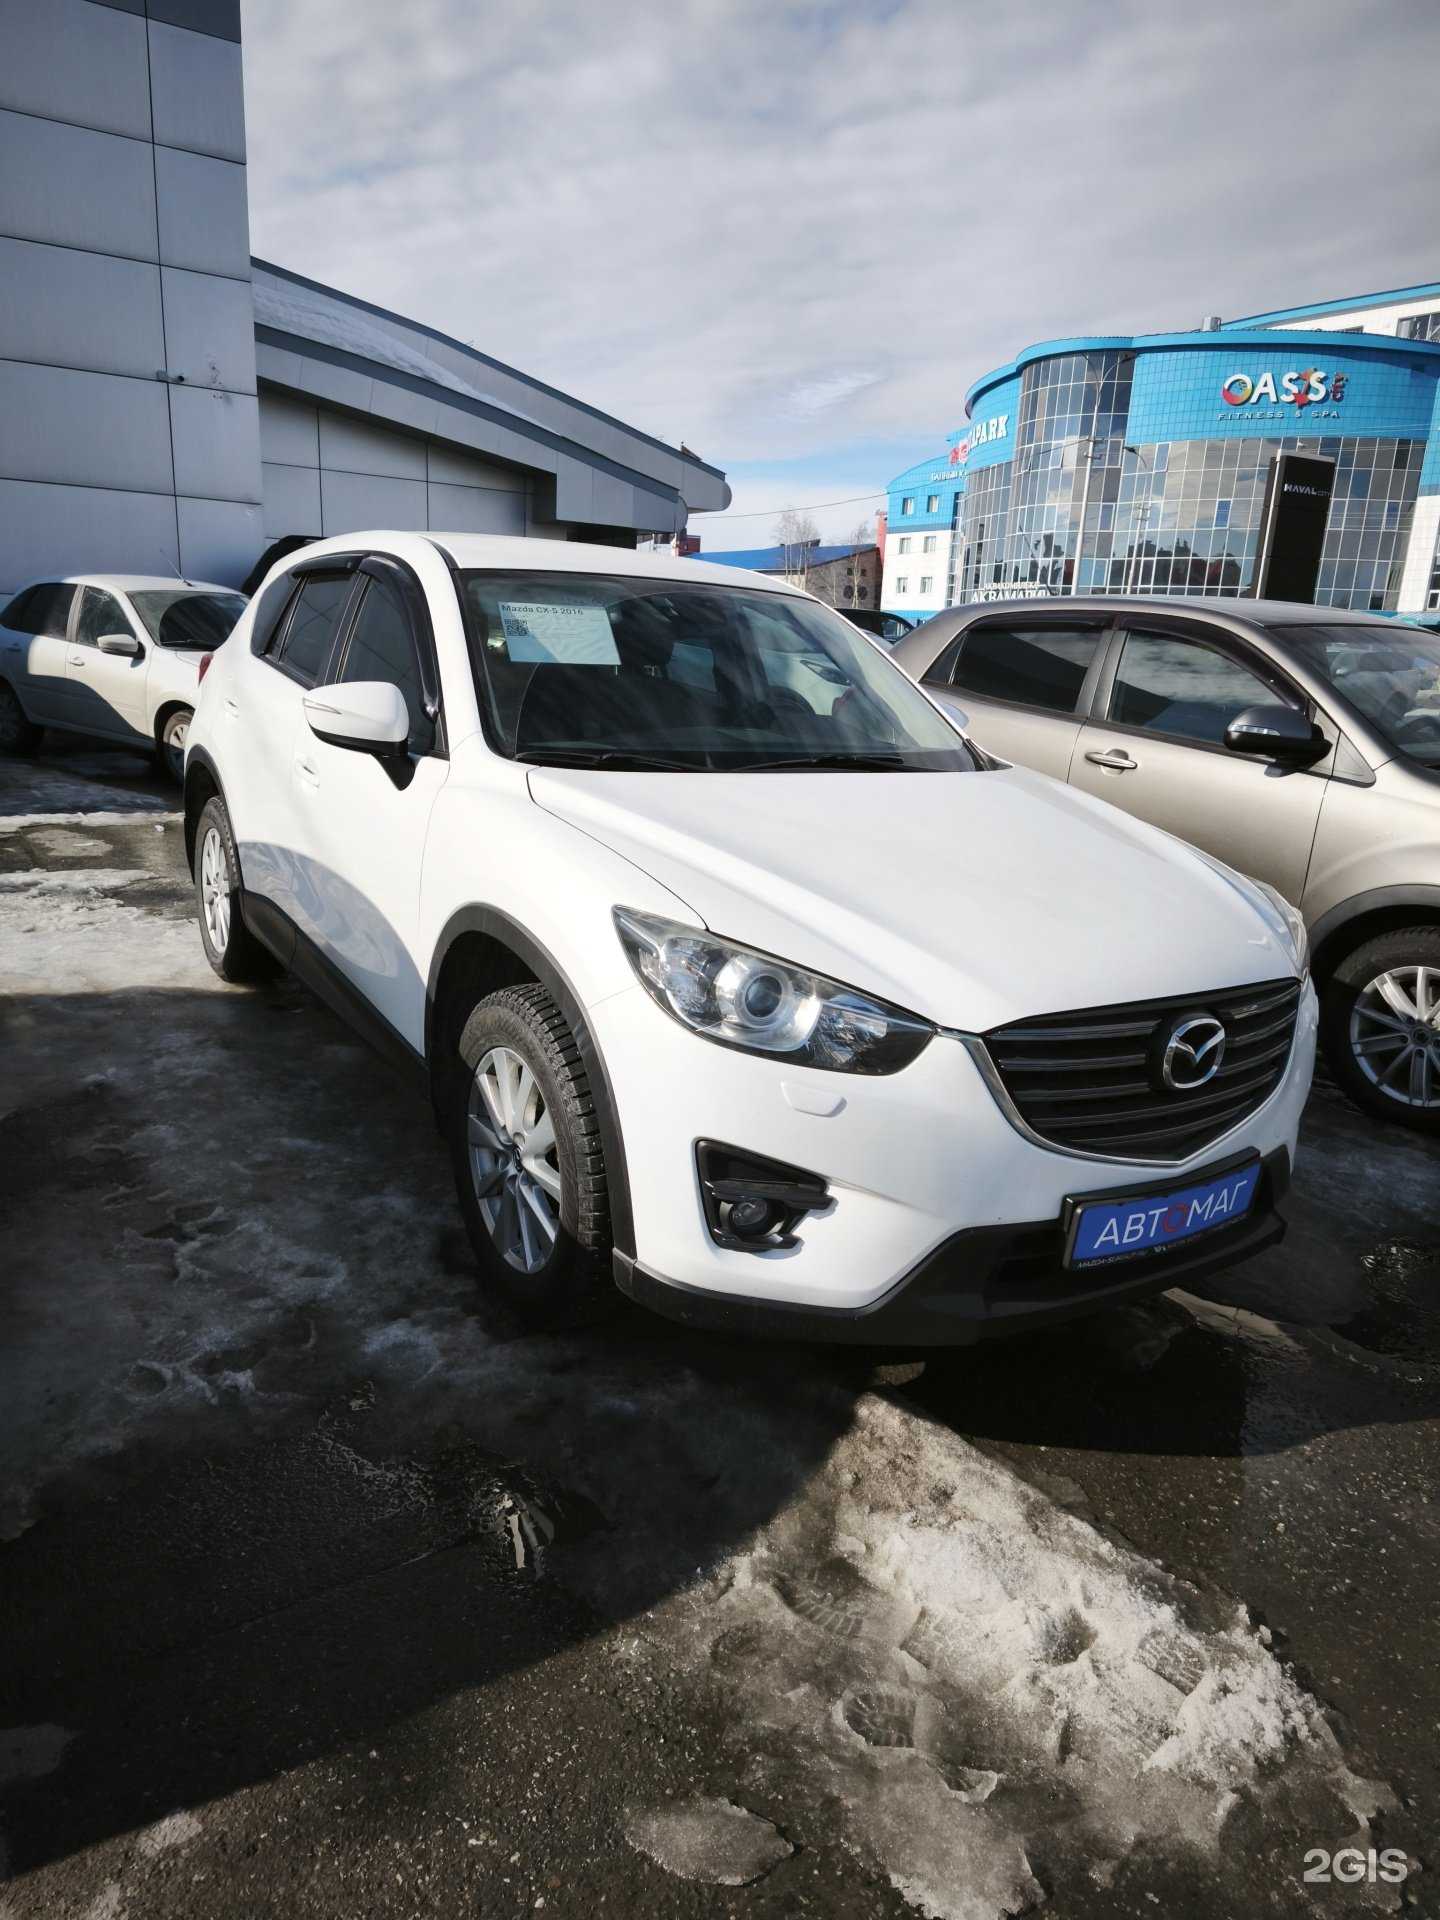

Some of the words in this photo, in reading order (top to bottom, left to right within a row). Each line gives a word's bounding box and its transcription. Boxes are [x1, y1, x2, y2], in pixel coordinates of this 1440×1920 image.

[1218, 411, 1285, 421] FITNESS
[1311, 409, 1340, 419] SPA
[1284, 483, 1317, 495] HAVAL
[971, 590, 1051, 604] АКВАМАРИ
[501, 604, 534, 613] Mazda
[536, 606, 558, 614] CX-5
[1093, 1180, 1248, 1249] АВТОМАГ
